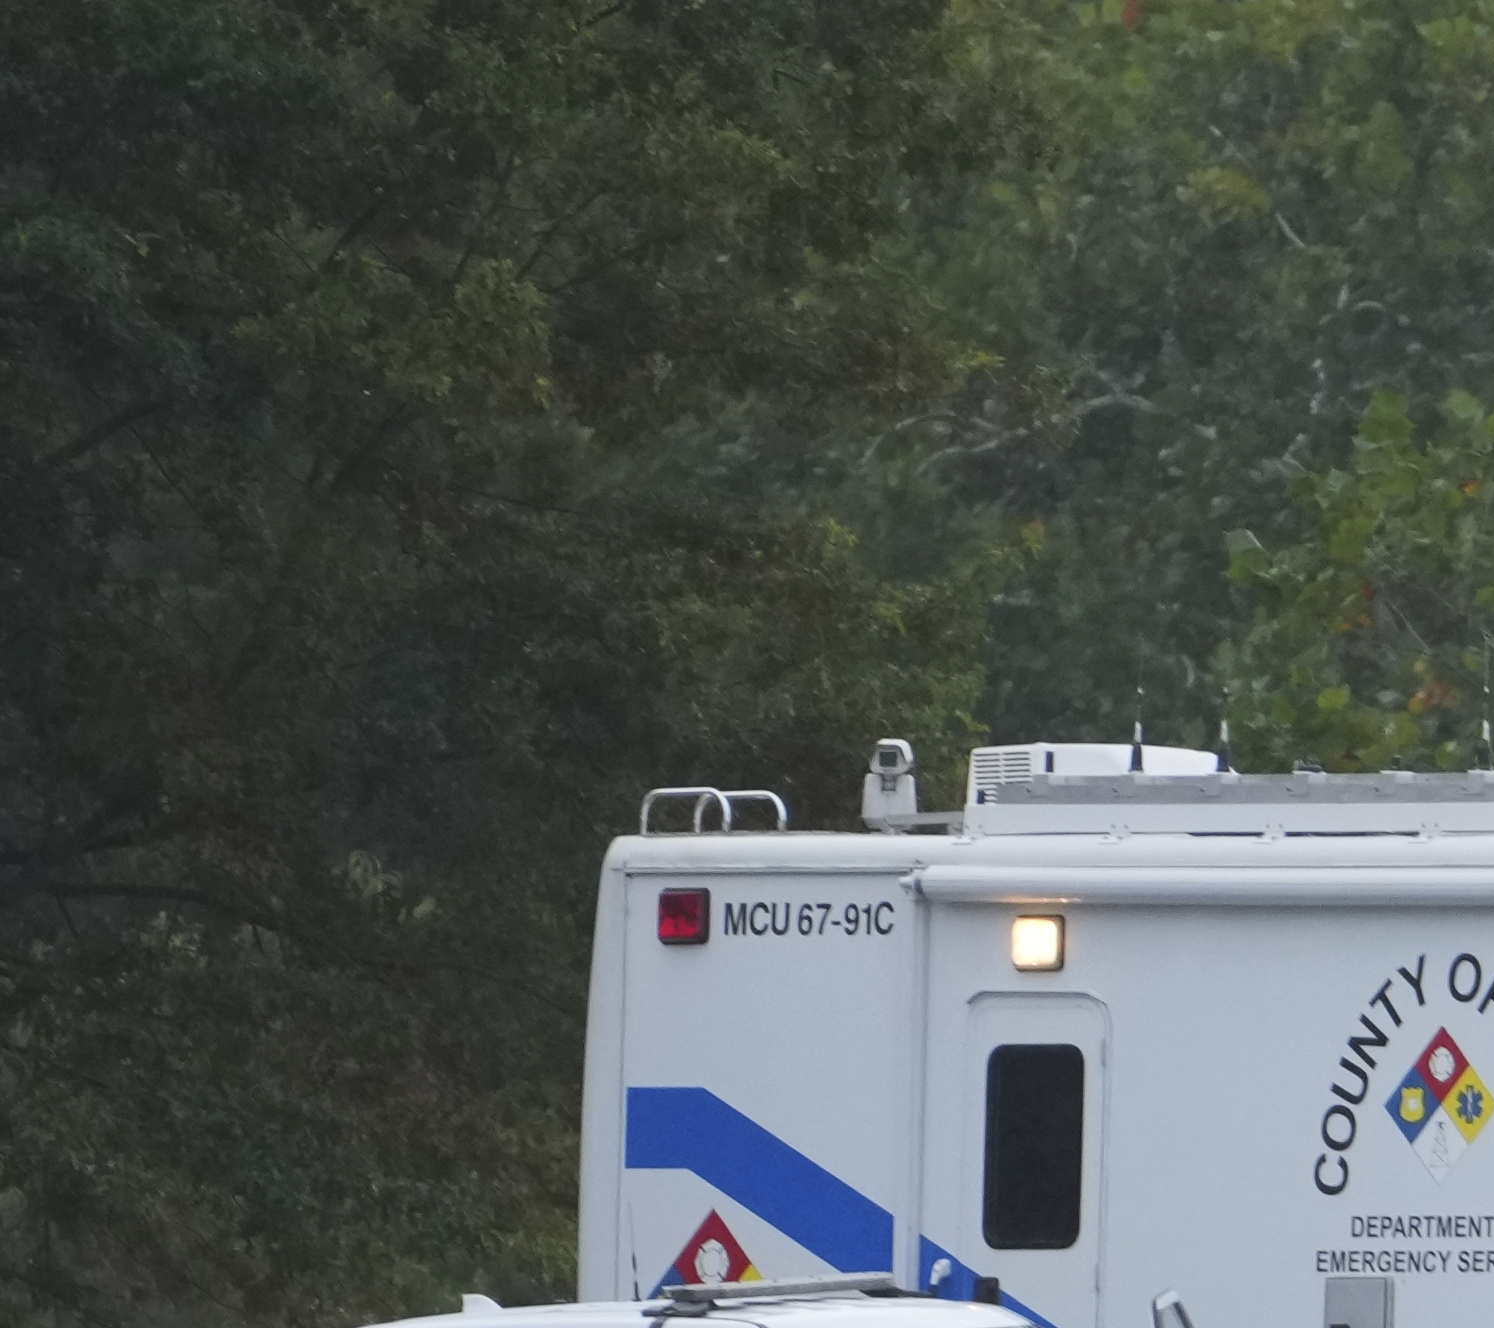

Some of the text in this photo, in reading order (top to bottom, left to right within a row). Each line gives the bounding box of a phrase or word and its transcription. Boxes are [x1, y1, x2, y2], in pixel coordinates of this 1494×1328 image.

[723, 902, 895, 936] MCU 67-91C
[1313, 954, 1426, 1196] COUNTY
[1315, 1250, 1451, 1273] EMERGENCY
